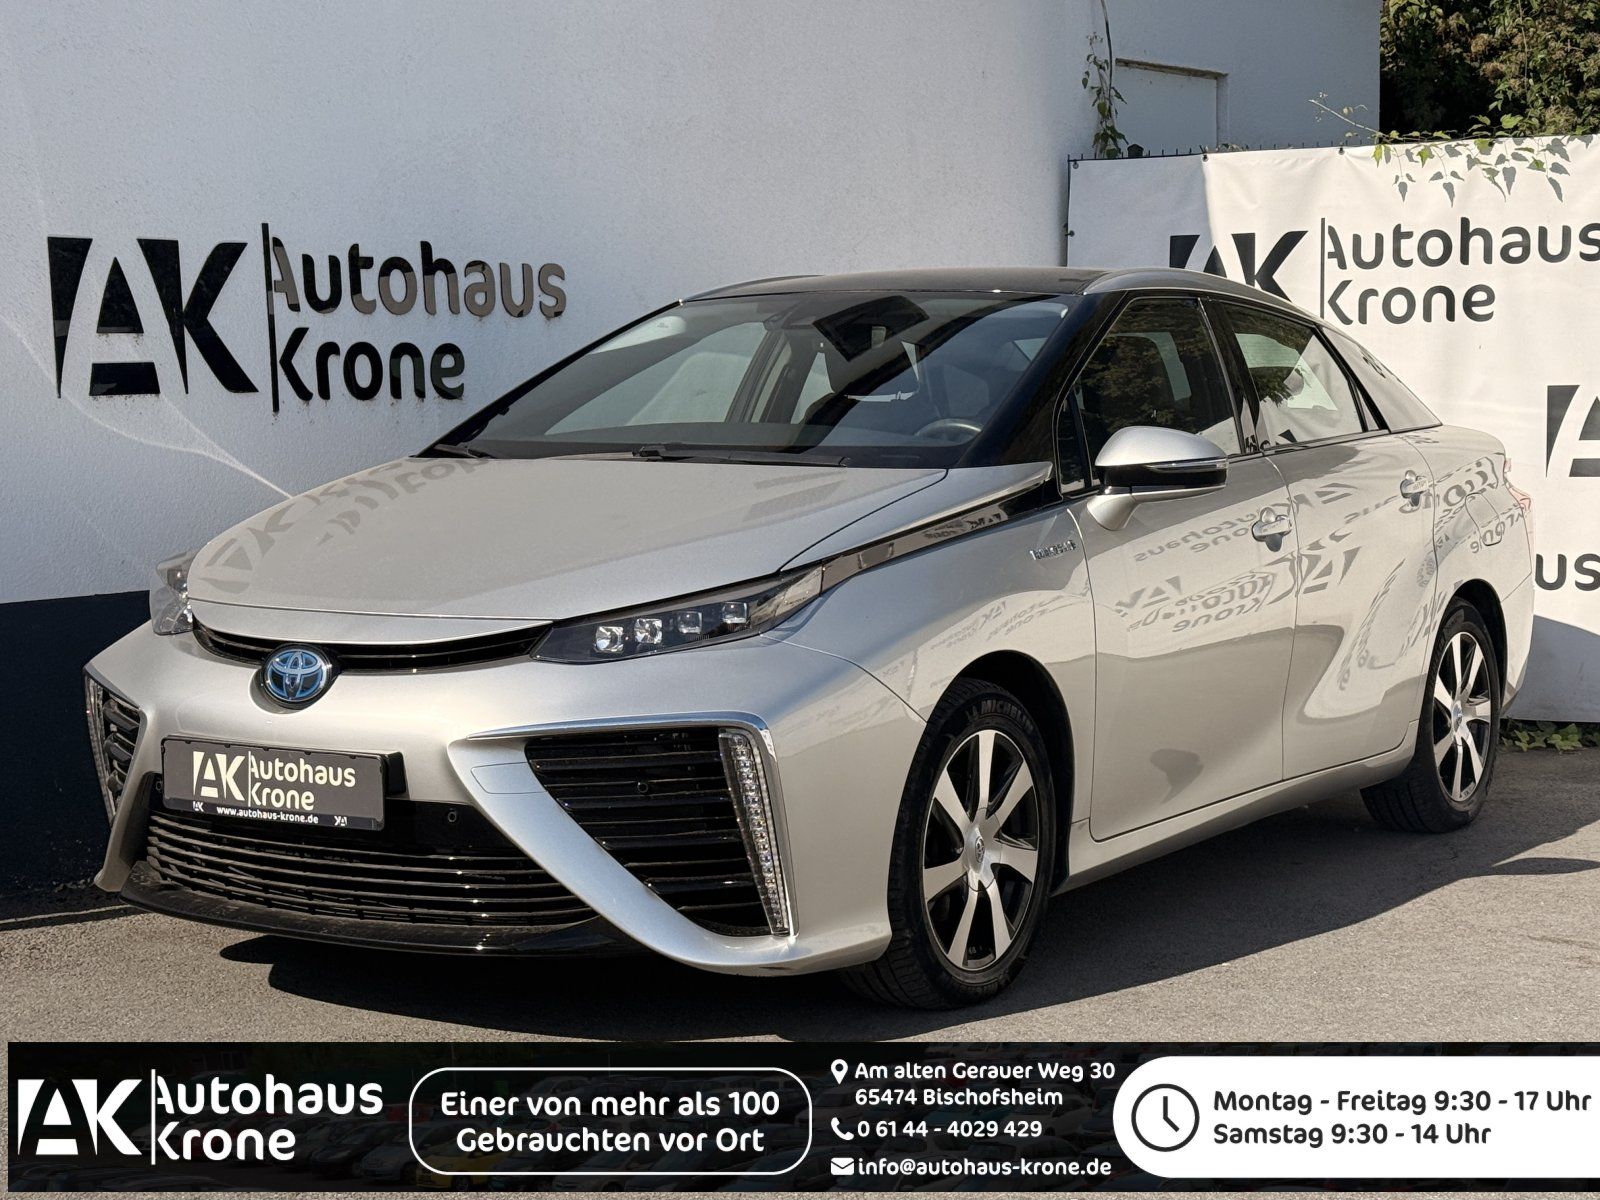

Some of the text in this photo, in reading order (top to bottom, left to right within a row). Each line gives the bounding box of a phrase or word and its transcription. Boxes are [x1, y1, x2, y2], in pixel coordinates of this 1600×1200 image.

[1327, 217, 1600, 270] Autohaus
[272, 236, 566, 319] Autohaus
[1327, 279, 1496, 326] Krone
[47, 236, 259, 398] AK
[278, 327, 465, 401] Krone
[193, 751, 245, 801] AK
[250, 753, 356, 787] Autohaus
[216, 806, 319, 824] www.autohaus-krone.de
[250, 782, 315, 811] Krone
